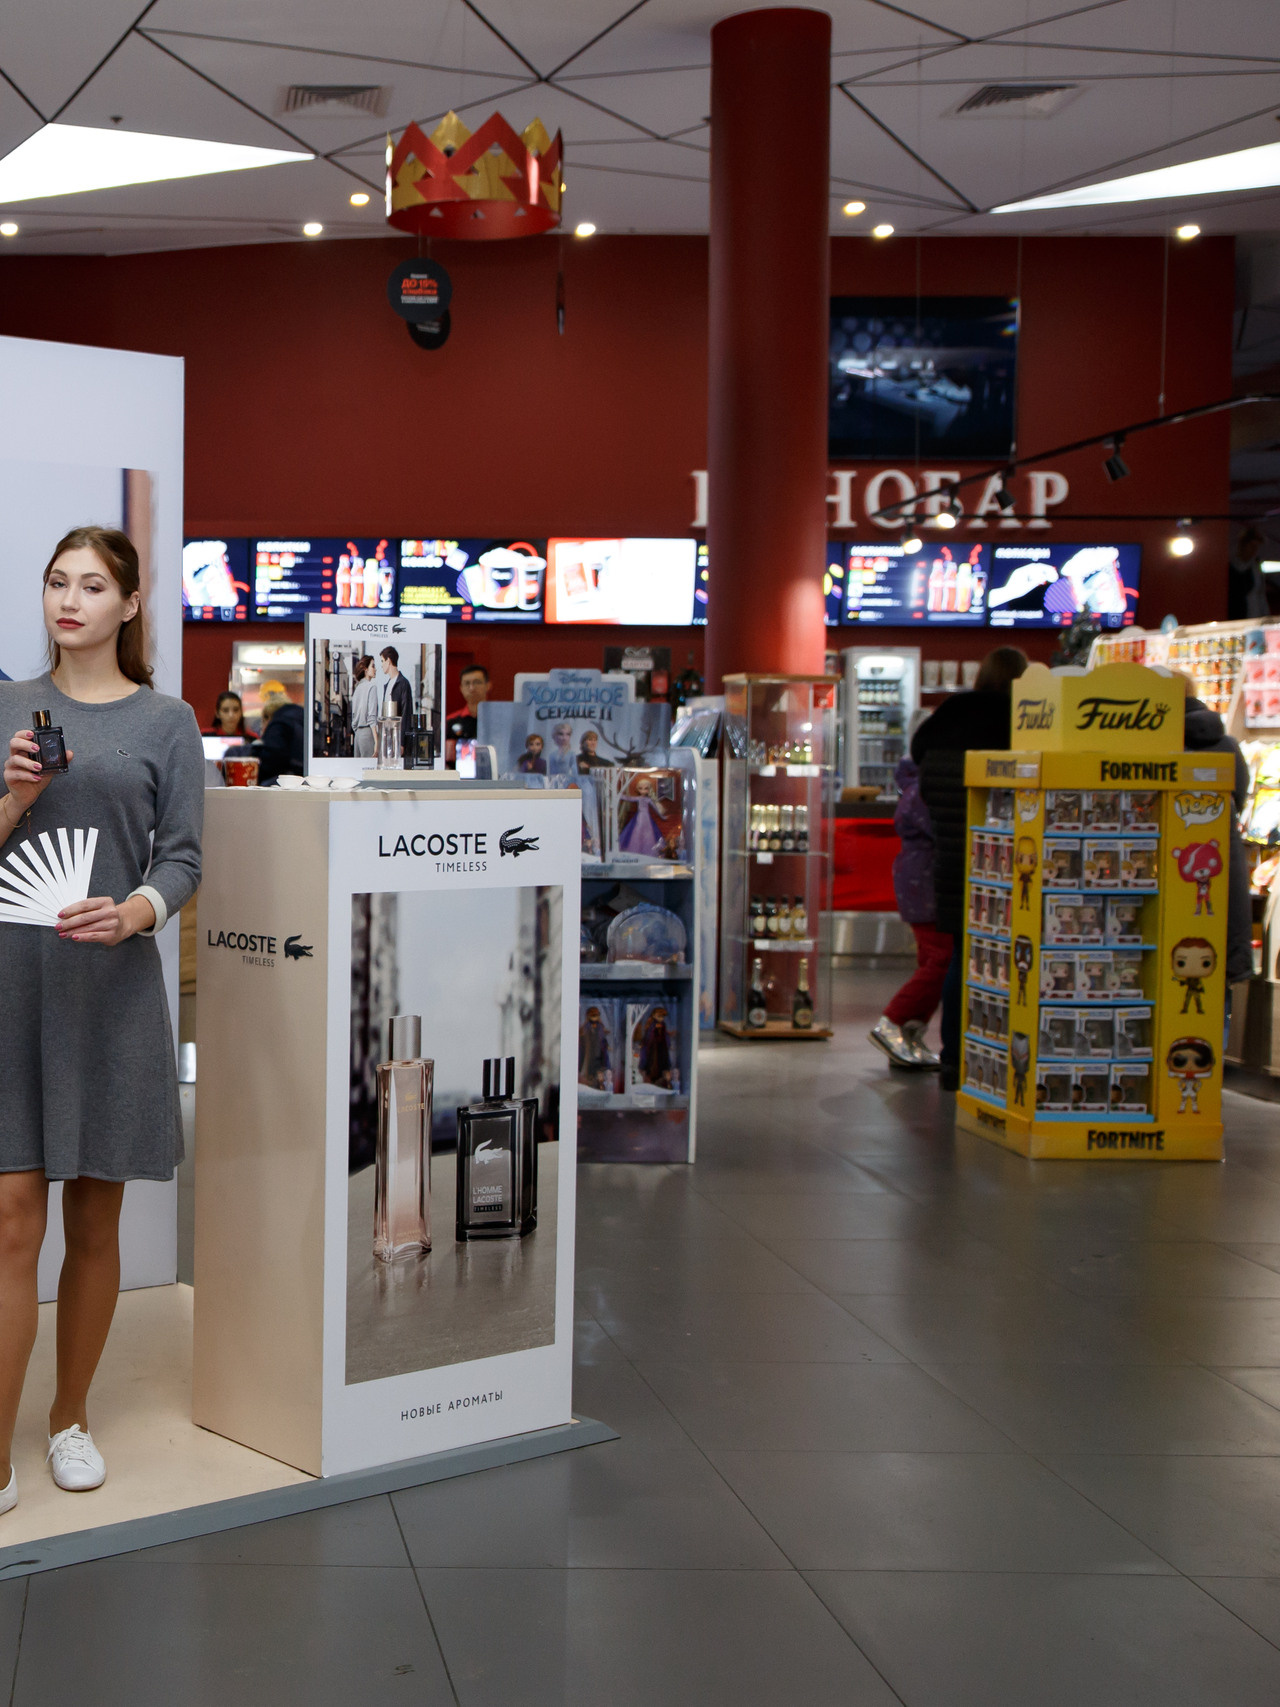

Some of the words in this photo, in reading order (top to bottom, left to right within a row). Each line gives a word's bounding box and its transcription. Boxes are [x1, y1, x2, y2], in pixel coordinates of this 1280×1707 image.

[691, 469, 1069, 529] НОБАР
[350, 623, 389, 633] LACOSTE
[527, 685, 624, 707] ХОЛОДНОЕ
[535, 704, 597, 721] СЕРДЦЕ
[1017, 698, 1056, 731] Funko
[1076, 697, 1166, 731] Funko
[1100, 761, 1179, 782] FORTNITE
[378, 833, 487, 857] LACOSTE
[435, 861, 487, 873] TIMELESS
[208, 929, 277, 954] LACOSTE
[242, 955, 275, 968] TIMELESS
[1087, 1129, 1165, 1151] FORTNITE
[472, 1194, 503, 1204] LACOSTE
[401, 1403, 441, 1421] НОВЫЕ
[447, 1390, 503, 1412] АРОМАТЫ
